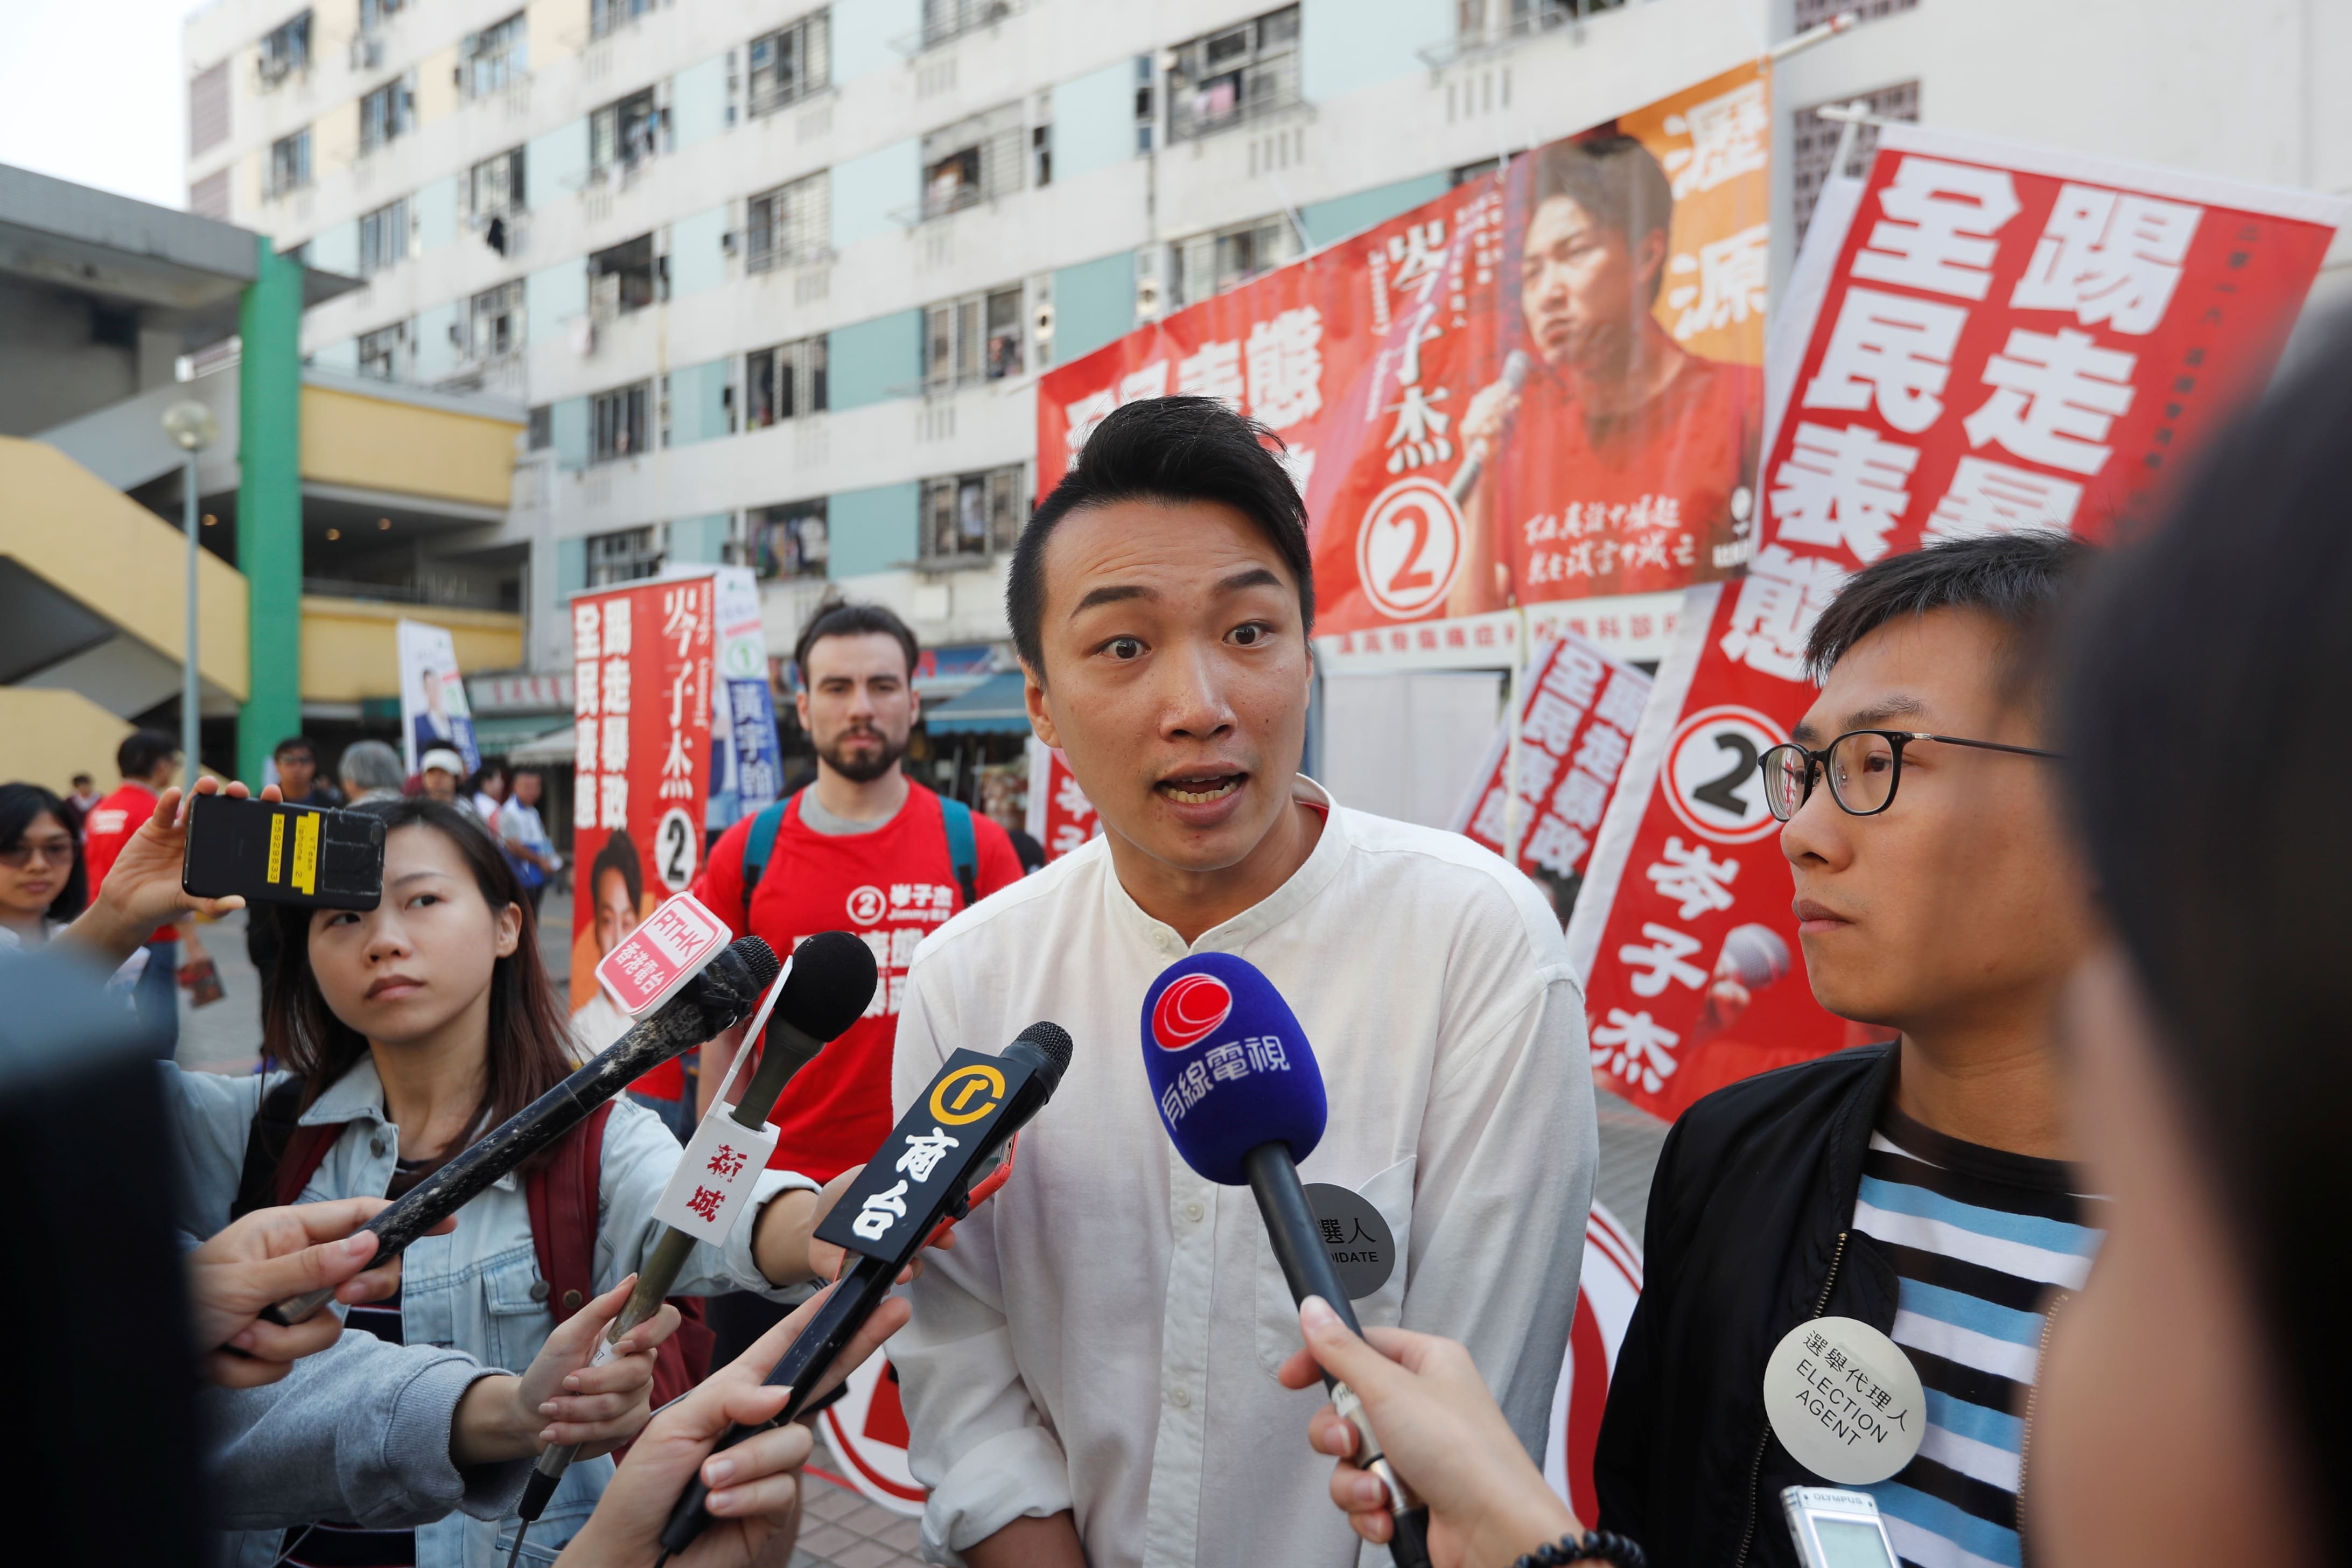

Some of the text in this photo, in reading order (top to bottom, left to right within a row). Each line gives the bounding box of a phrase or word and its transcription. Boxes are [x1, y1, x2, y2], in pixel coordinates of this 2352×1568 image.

[1720, 155, 2022, 689] 全民表態
[1388, 503, 1434, 593] 2
[574, 603, 600, 830] 全民表態
[600, 597, 632, 830] 踢走暴政
[1693, 732, 1759, 817] 2
[667, 817, 685, 881] 2
[654, 909, 705, 957] RTHK
[857, 893, 877, 916] 2
[614, 941, 665, 995] 香港電台
[1592, 836, 1740, 1095] 岑子杰
[1161, 1035, 1291, 1132] 有線電視
[685, 1144, 747, 1223] 新城
[851, 1126, 960, 1241] 商台
[1331, 1251, 1379, 1263] IDATE
[1795, 1389, 1861, 1446] AGENT
[1796, 1359, 1888, 1444] ELECTION
[1802, 1330, 1908, 1432] 選舉代理人
[1812, 1493, 1863, 1504] OLYMPUS
